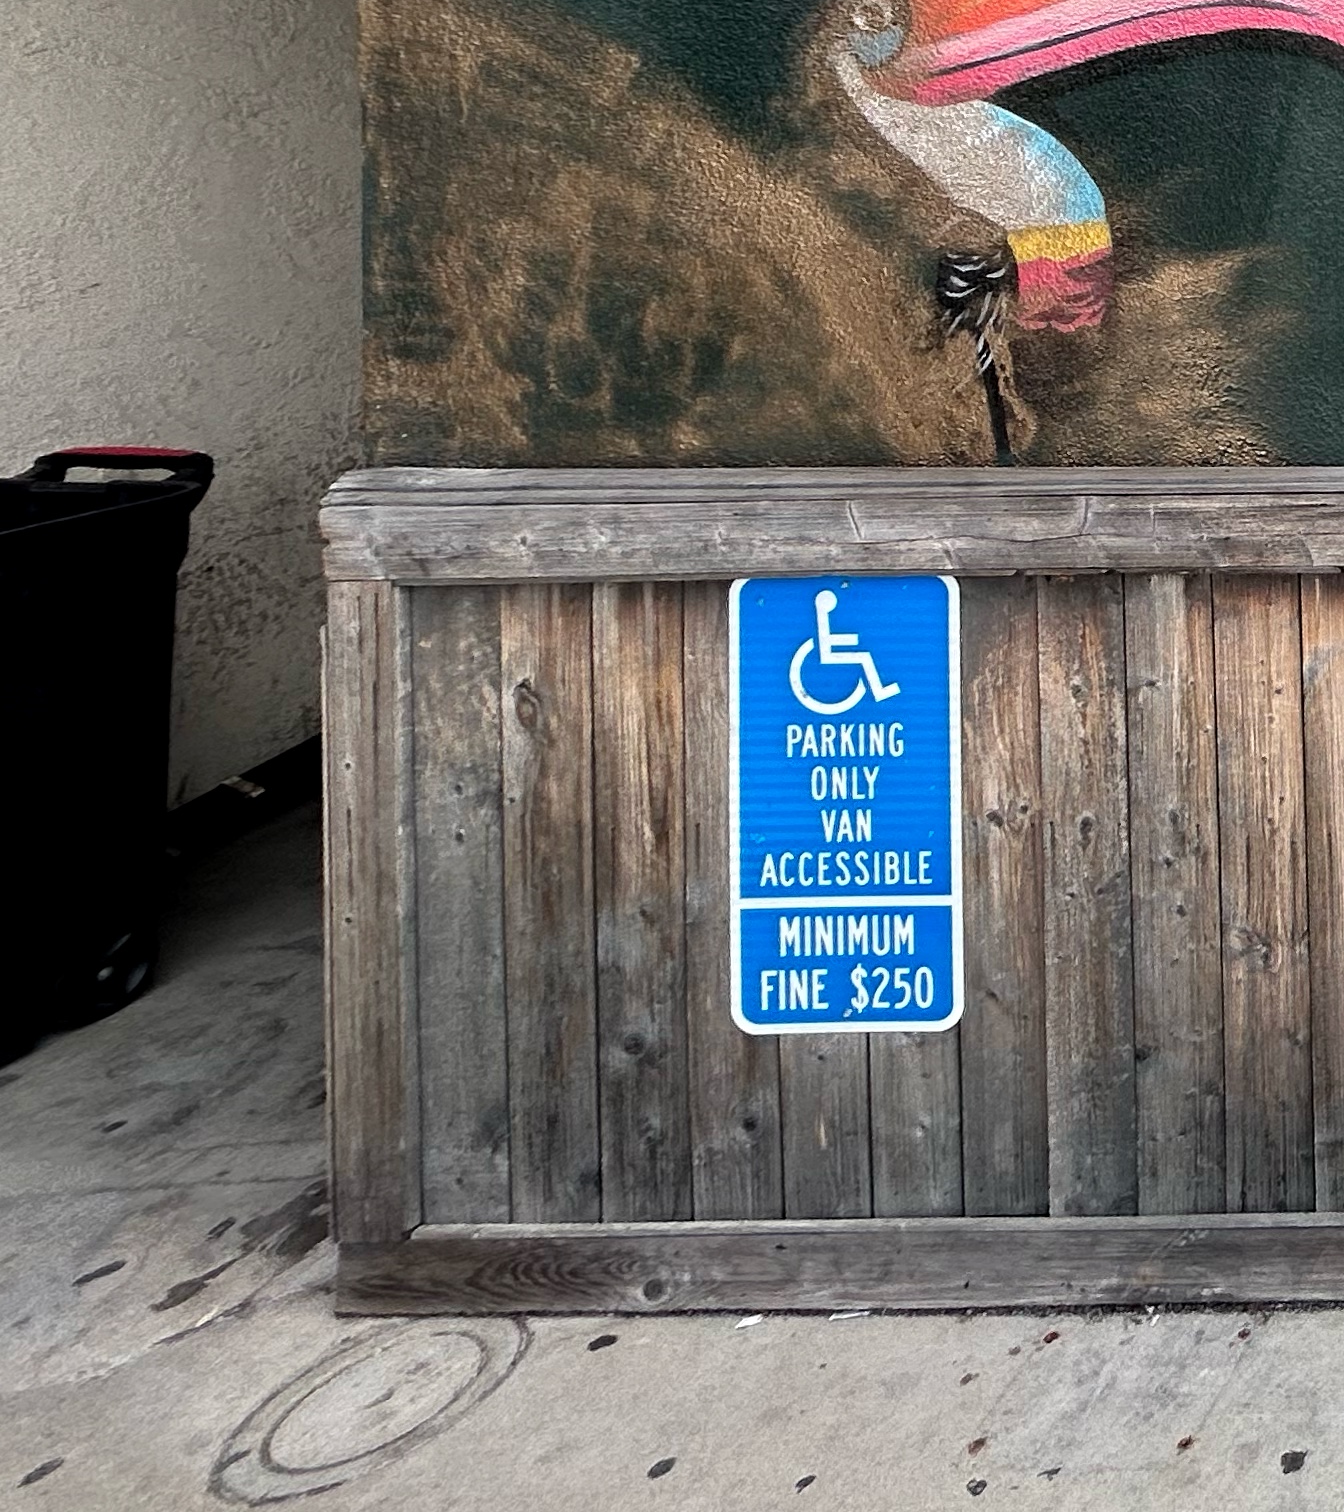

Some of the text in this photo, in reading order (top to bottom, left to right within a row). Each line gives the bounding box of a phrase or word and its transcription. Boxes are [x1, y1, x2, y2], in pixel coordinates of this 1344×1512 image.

[786, 722, 904, 758] PARKING
[811, 765, 879, 801] ONLY
[821, 809, 872, 843] VAN
[760, 850, 933, 887] ACCESSIBLE
[779, 914, 915, 957] MINIMUM
[760, 963, 934, 1013] FINE $250
